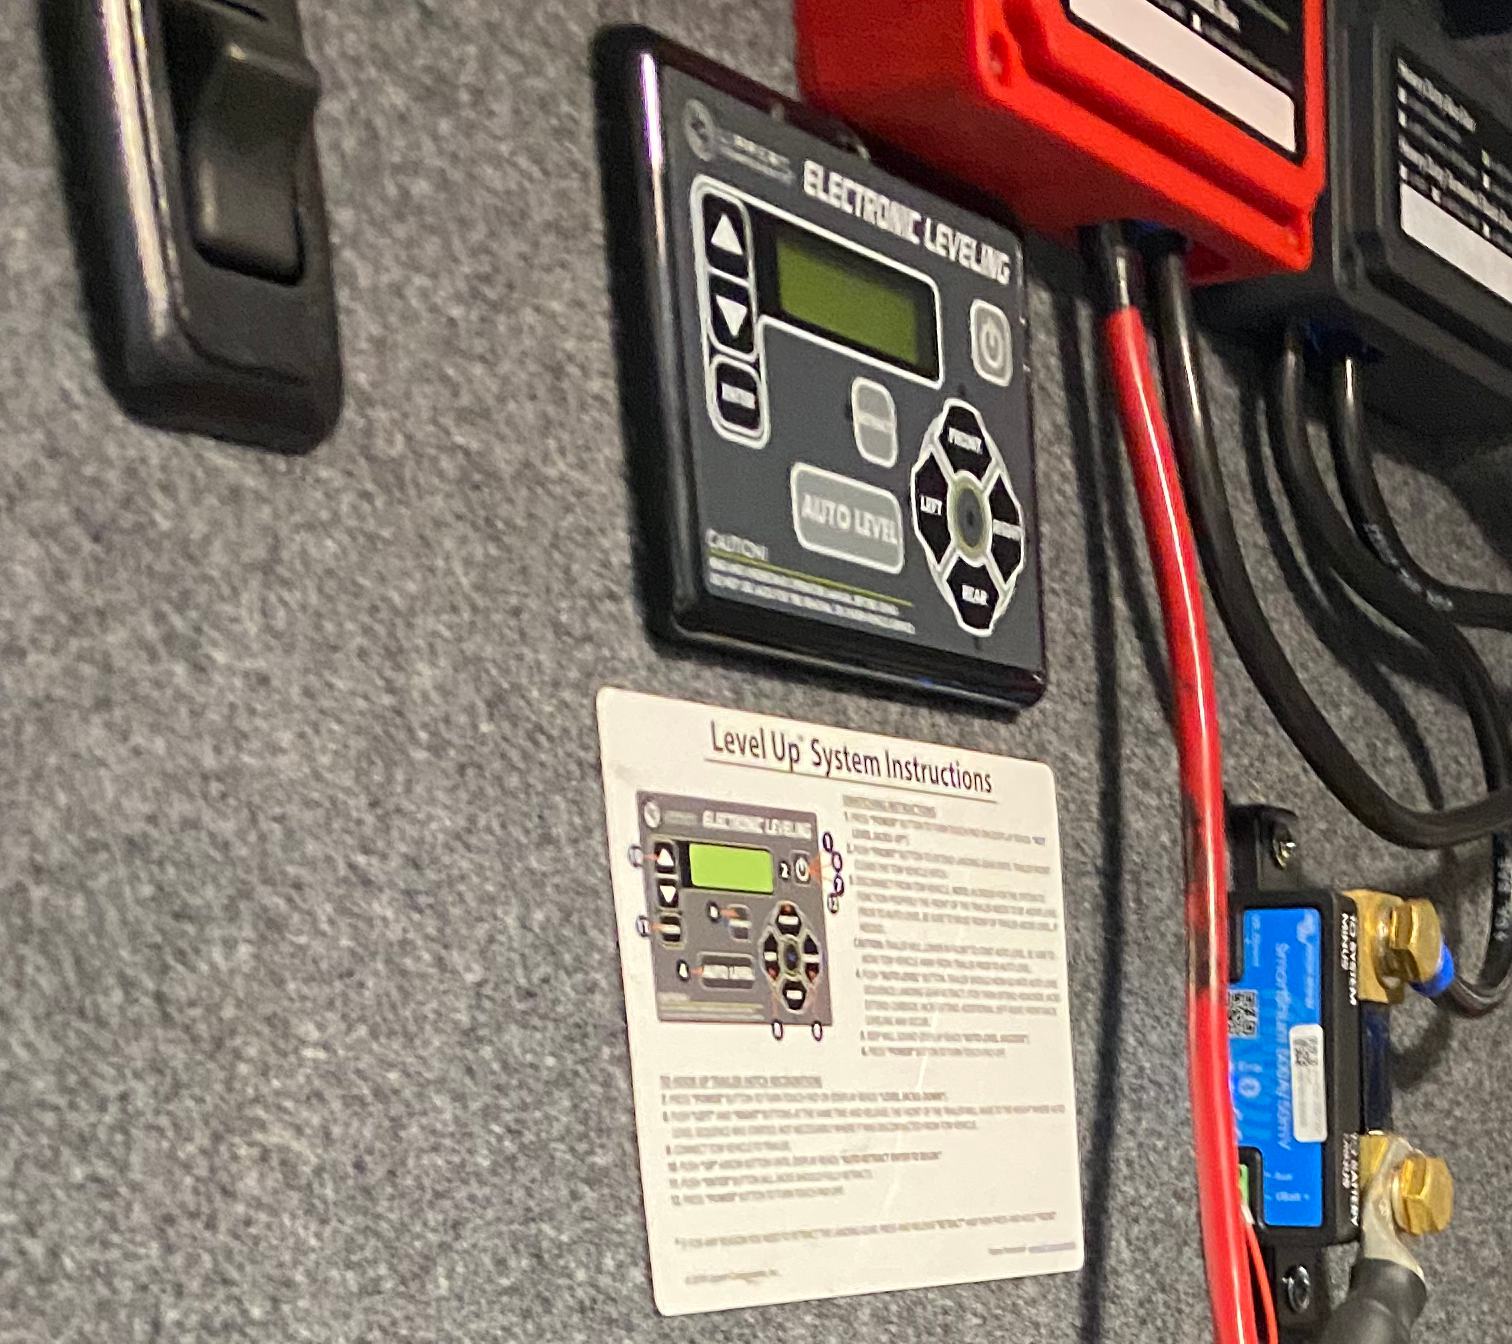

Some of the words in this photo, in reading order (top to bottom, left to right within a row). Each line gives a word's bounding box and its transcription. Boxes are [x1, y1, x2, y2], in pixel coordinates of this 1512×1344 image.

[802, 159, 922, 244] ELECTRONIC
[924, 217, 1011, 286] LEVELING
[801, 493, 851, 530] AUTO
[854, 510, 898, 546] LEVEL
[710, 720, 766, 760] Level
[810, 738, 882, 778] System
[885, 750, 993, 794] Instructions
